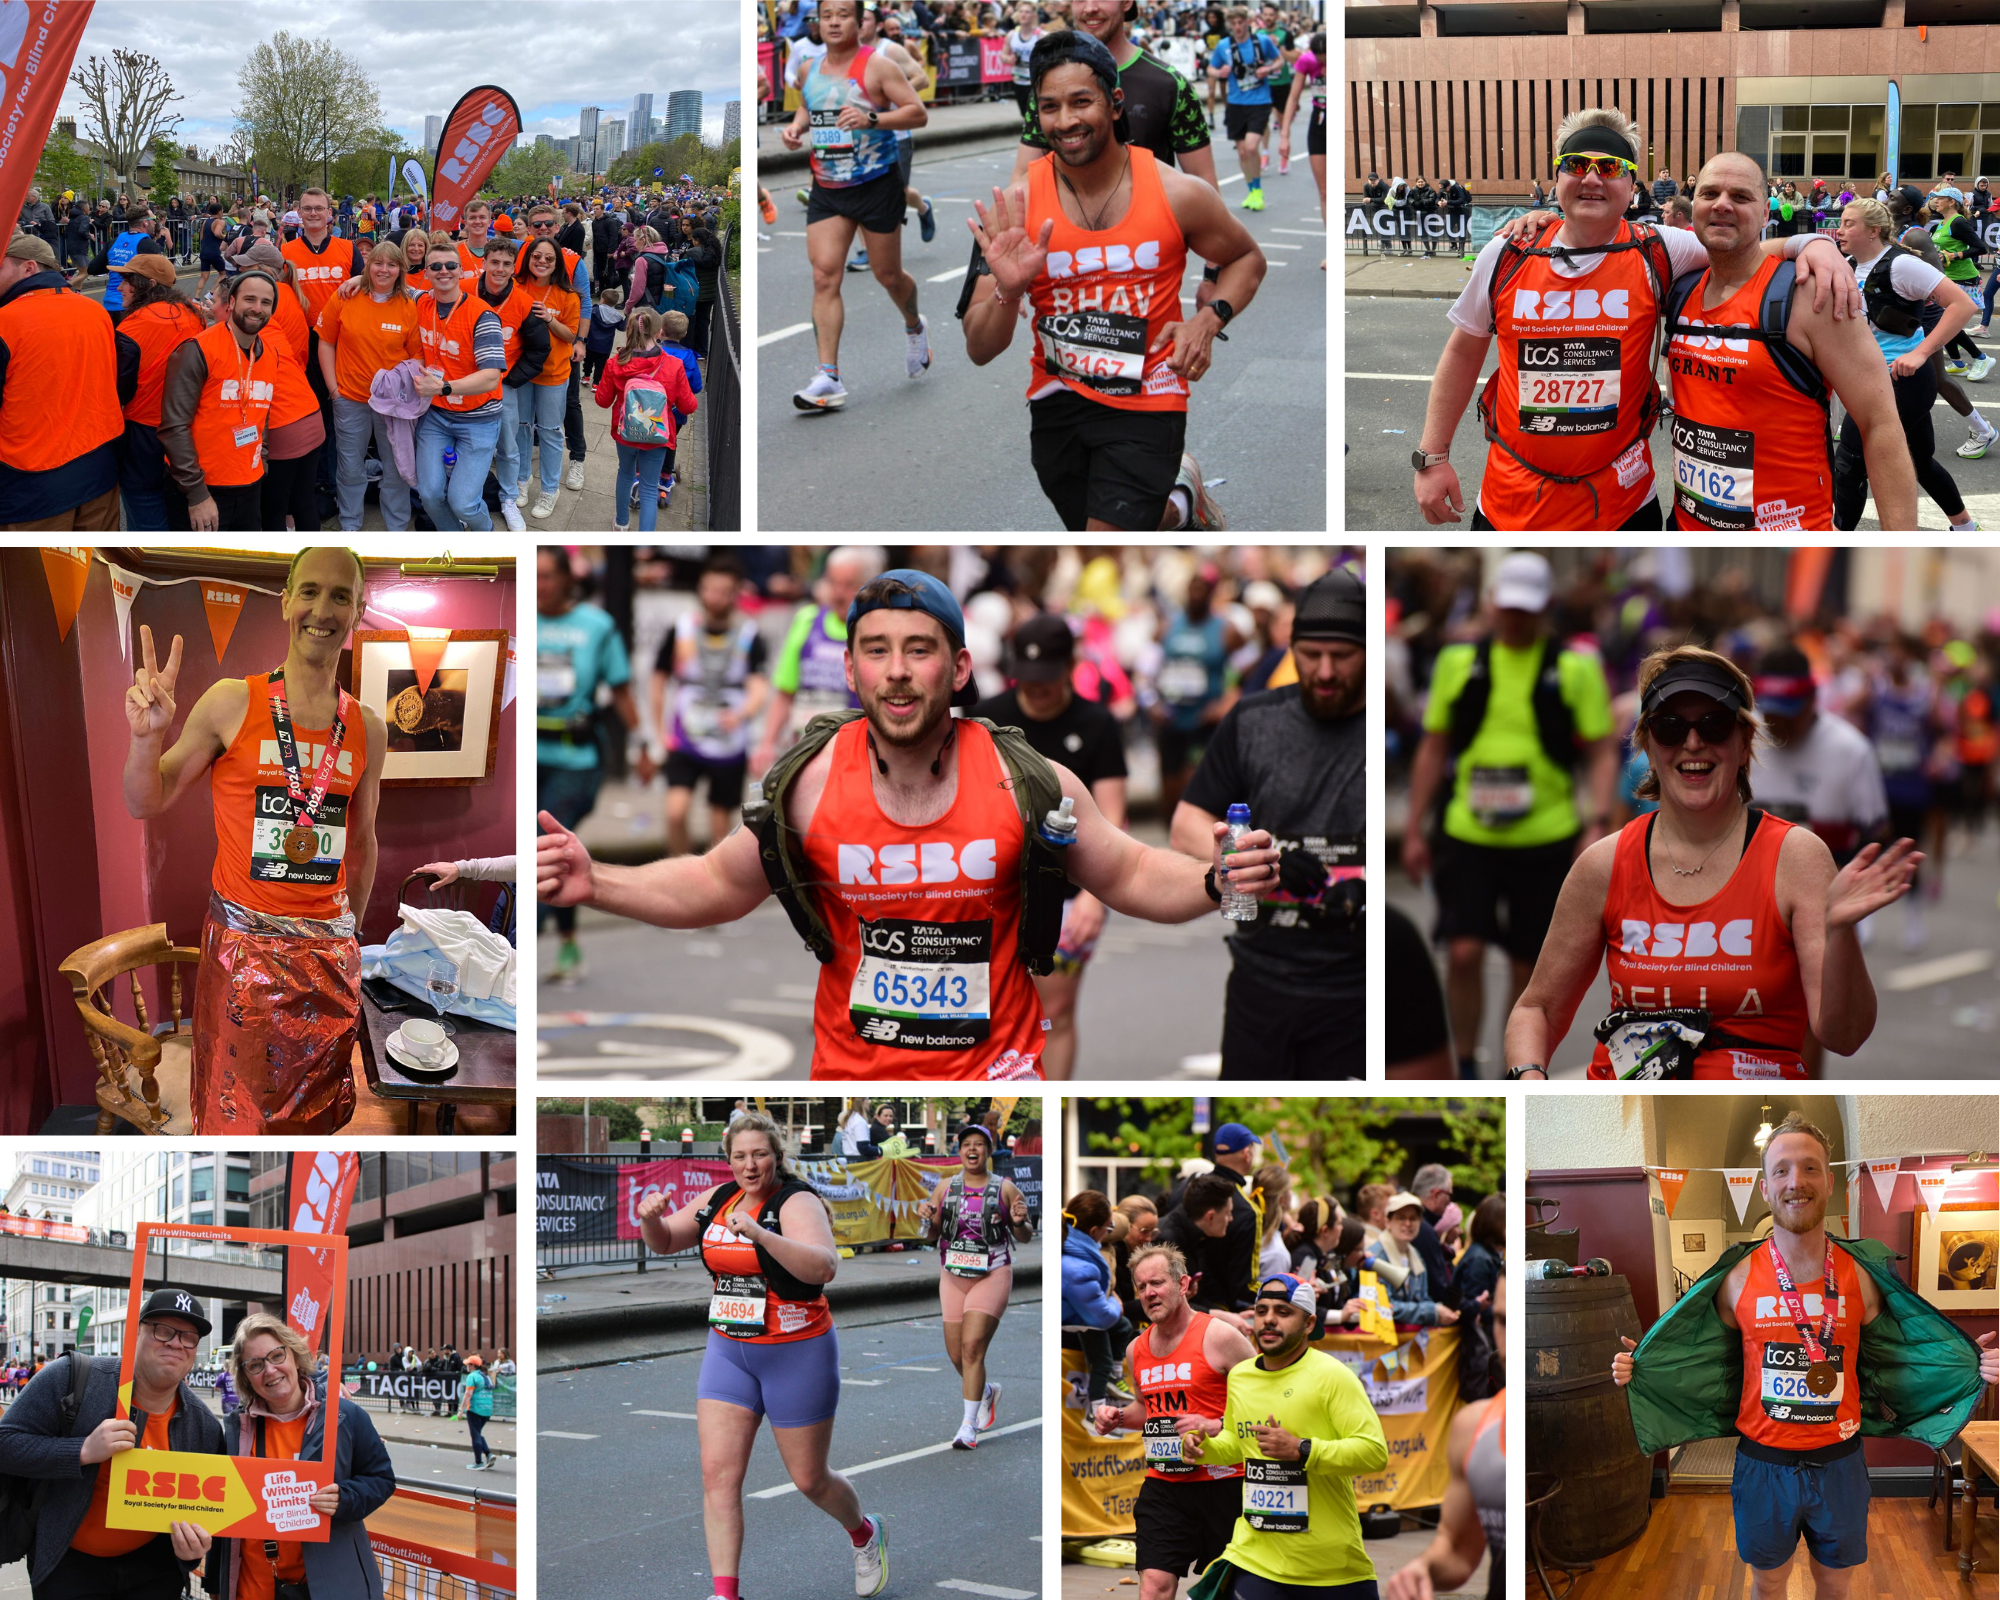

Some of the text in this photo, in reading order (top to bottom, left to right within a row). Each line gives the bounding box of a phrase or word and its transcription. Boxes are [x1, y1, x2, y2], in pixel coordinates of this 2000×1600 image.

[16, 26, 48, 104] for Blind
[440, 101, 506, 184] RSBC
[815, 130, 841, 144] 2389
[461, 174, 474, 189] Royal
[471, 156, 485, 178] Society
[497, 116, 513, 138] Children
[1046, 241, 1160, 279] RSBC
[297, 266, 343, 281] RSBC
[1052, 282, 1155, 317] BHAV
[1512, 289, 1629, 320] RSBC
[1087, 315, 1110, 326] TATA
[1085, 325, 1141, 340] CONSULTANCY
[1512, 324, 1530, 333] Royal
[1532, 325, 1560, 334] Society
[1084, 333, 1119, 346] SERVICES
[1524, 343, 1559, 365] tcs
[1717, 356, 1748, 365] Children
[1563, 358, 1596, 366] SERVICES
[1671, 357, 1737, 385] GRANT
[1533, 379, 1605, 403] 28727
[1557, 423, 1574, 432] new
[1576, 420, 1610, 431] balance
[1674, 418, 1694, 451] tcs
[1697, 428, 1717, 440] TATA
[1696, 445, 1727, 460] SERVICES
[1697, 437, 1747, 453] CONSULTANCY
[1618, 454, 1642, 473] Limits
[1679, 459, 1736, 502] 67162
[1758, 507, 1803, 525] Without
[1763, 503, 1782, 515] Life
[1696, 511, 1745, 529] new balance
[207, 589, 240, 605] RSBC
[274, 695, 285, 722] FINISHER
[332, 721, 342, 747] FINISHER
[258, 769, 277, 777] Royal
[318, 767, 331, 780] tcs
[286, 765, 302, 797] 2024
[306, 786, 324, 816] 2024
[838, 839, 997, 885] RSBC
[841, 887, 994, 902] Royal Society for Blind Children
[912, 925, 943, 935] TATA
[911, 935, 982, 946] CONSULTANCY
[1620, 919, 1753, 958] RSBC
[911, 947, 956, 956] SERVICES
[1619, 958, 1752, 973] Royal Society for Blind Children
[873, 971, 968, 1008] 65343
[900, 1034, 925, 1045] new
[926, 1034, 975, 1045] balance
[1737, 1067, 1778, 1077] For Blind
[1872, 1163, 1896, 1173] RSBC
[683, 1171, 712, 1186] TATA
[1660, 1172, 1683, 1181] RSBC
[148, 1228, 232, 1240] #LifeWithoutLimits
[952, 1254, 981, 1267] 29995
[175, 1293, 192, 1312] NY
[716, 1301, 755, 1319] 34694
[1755, 1320, 1794, 1329] Royal Society
[1823, 1313, 1833, 1339] FINISHER
[1766, 1345, 1795, 1366] tcs
[1141, 1363, 1191, 1386] RSBC
[1145, 1391, 1187, 1413] TIM
[1807, 1414, 1834, 1422] balance
[1246, 1462, 1264, 1480] tcs
[125, 1469, 226, 1502] RSBC
[270, 1473, 291, 1485] Life
[265, 1482, 313, 1498] Without
[124, 1499, 142, 1508] Royal
[143, 1501, 168, 1511] Society
[196, 1505, 224, 1513] Children
[271, 1495, 307, 1509] Limits
[1251, 1489, 1294, 1508] 49221
[270, 1508, 308, 1520] For Blind
[279, 1516, 317, 1529] Children
[1276, 1522, 1301, 1530] balance
